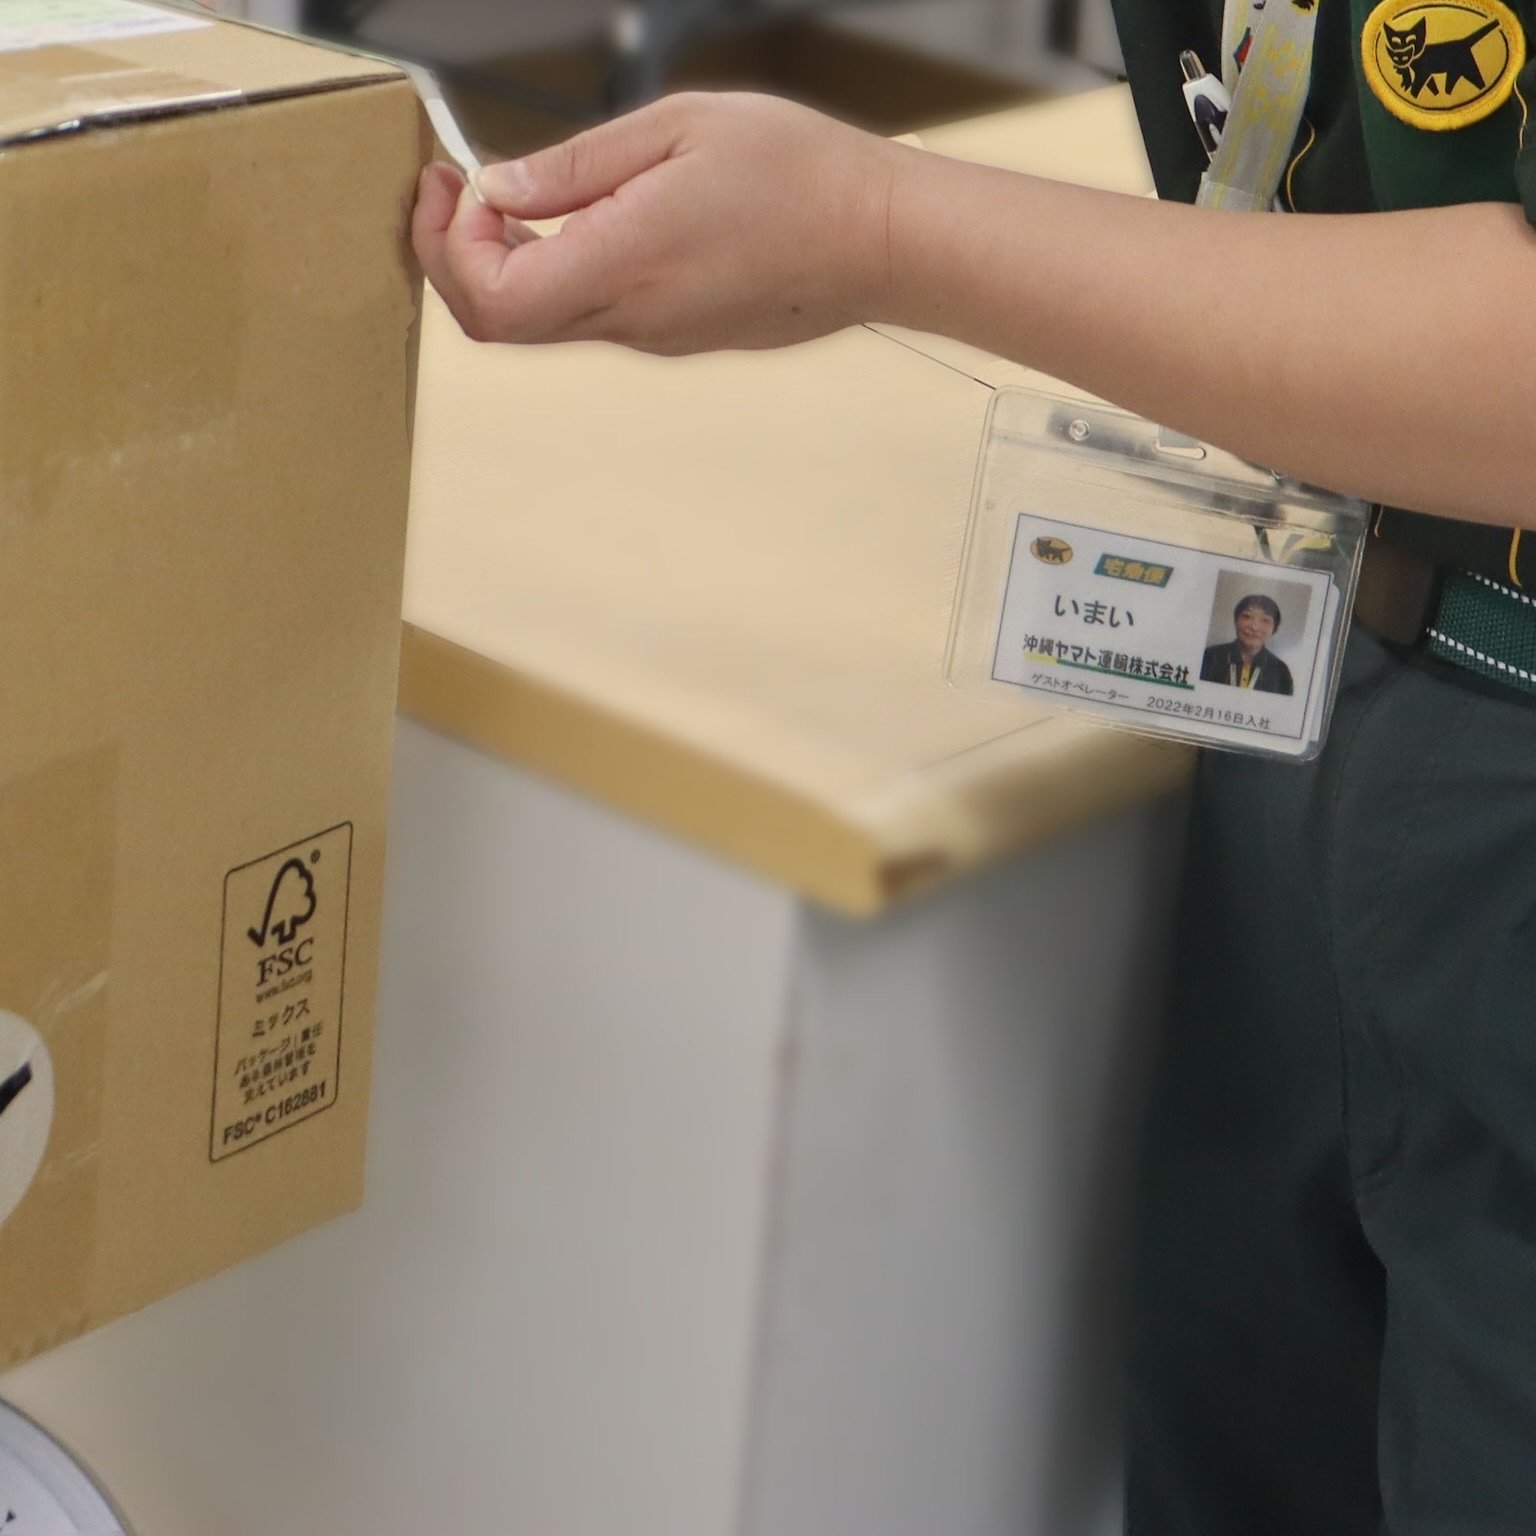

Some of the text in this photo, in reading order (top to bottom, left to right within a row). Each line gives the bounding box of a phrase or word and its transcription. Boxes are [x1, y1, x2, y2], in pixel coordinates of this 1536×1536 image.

[1054, 594, 1135, 629] いまい
[1023, 633, 1189, 684] 沖縄ヤマト運輸株式会社
[1146, 695, 1271, 729] 2022年2月16日入社
[255, 937, 314, 986] FSC
[252, 998, 310, 1037] ミックス
